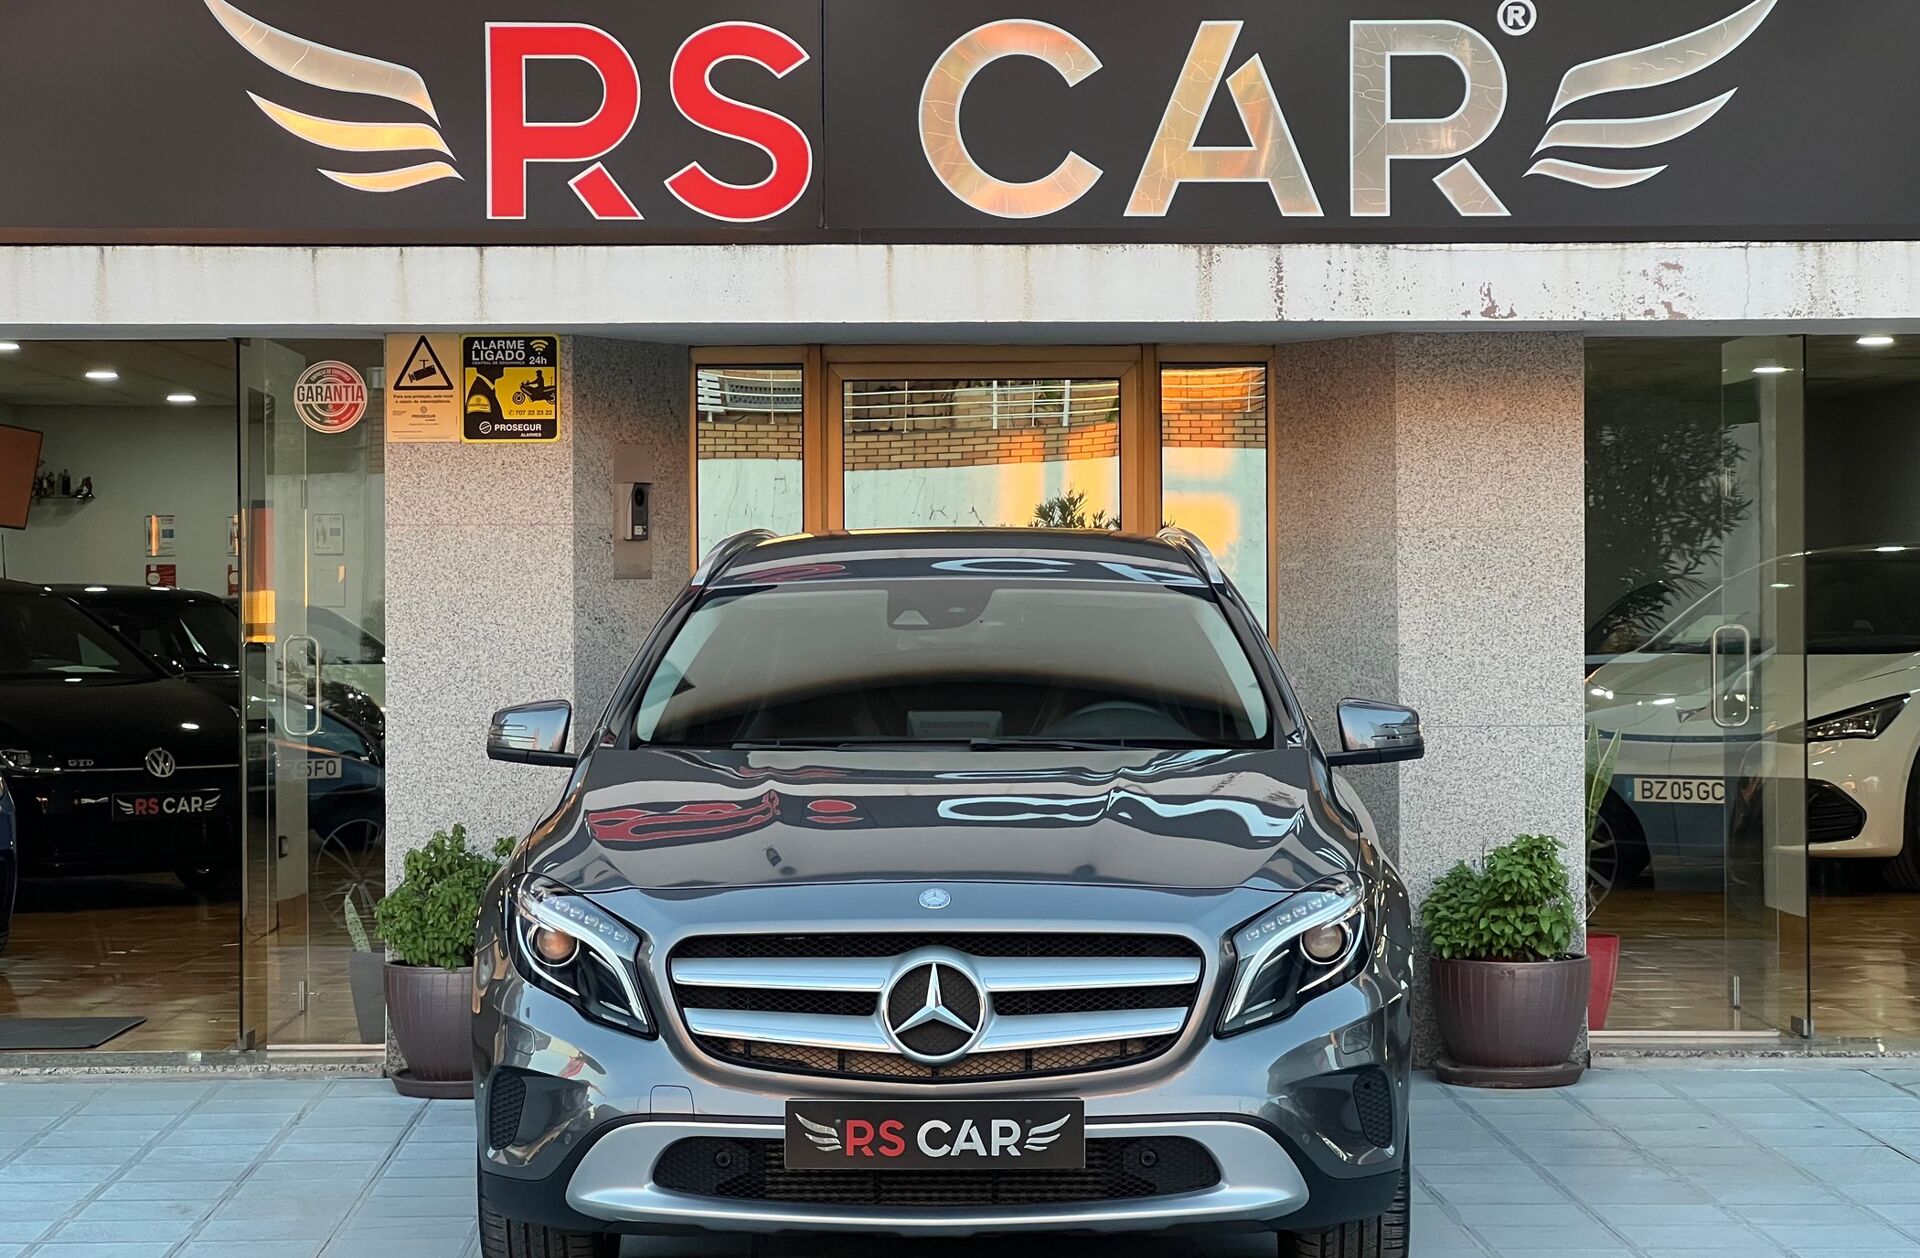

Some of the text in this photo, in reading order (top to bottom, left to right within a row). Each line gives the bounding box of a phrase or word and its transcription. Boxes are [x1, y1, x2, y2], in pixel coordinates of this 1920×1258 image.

[485, 21, 813, 222] RS
[918, 18, 1511, 219] CAR
[472, 340, 525, 350] ALARME
[472, 350, 526, 361] LIGADO
[529, 356, 547, 365] 24h
[297, 385, 364, 402] GARANTIA
[494, 423, 542, 432] PROSEGUR
[134, 796, 203, 816] RS CAR
[846, 1119, 1022, 1158] RS CAR
